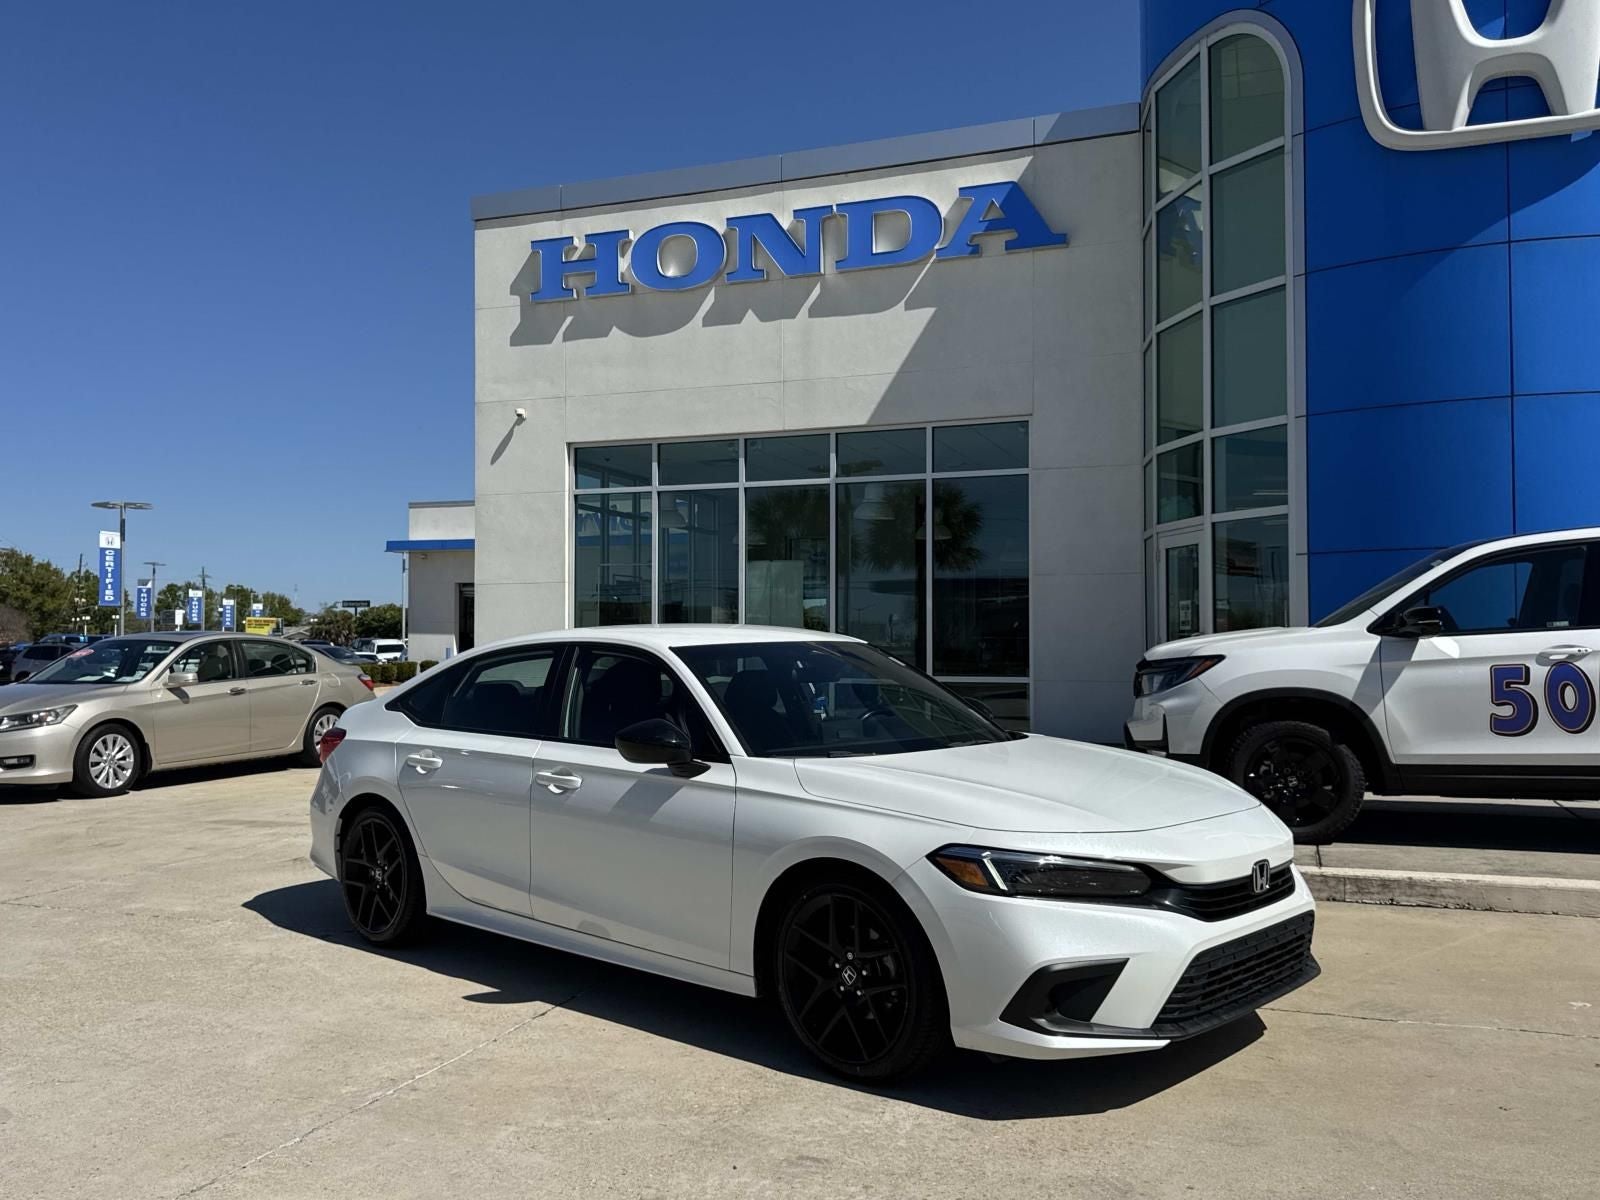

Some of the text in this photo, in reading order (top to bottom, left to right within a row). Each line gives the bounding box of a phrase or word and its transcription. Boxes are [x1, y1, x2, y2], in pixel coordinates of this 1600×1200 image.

[529, 180, 1068, 303] HONDA
[104, 549, 115, 601] CERTIFIED
[140, 588, 148, 617] TRUCKS
[1489, 660, 1597, 737] 50
